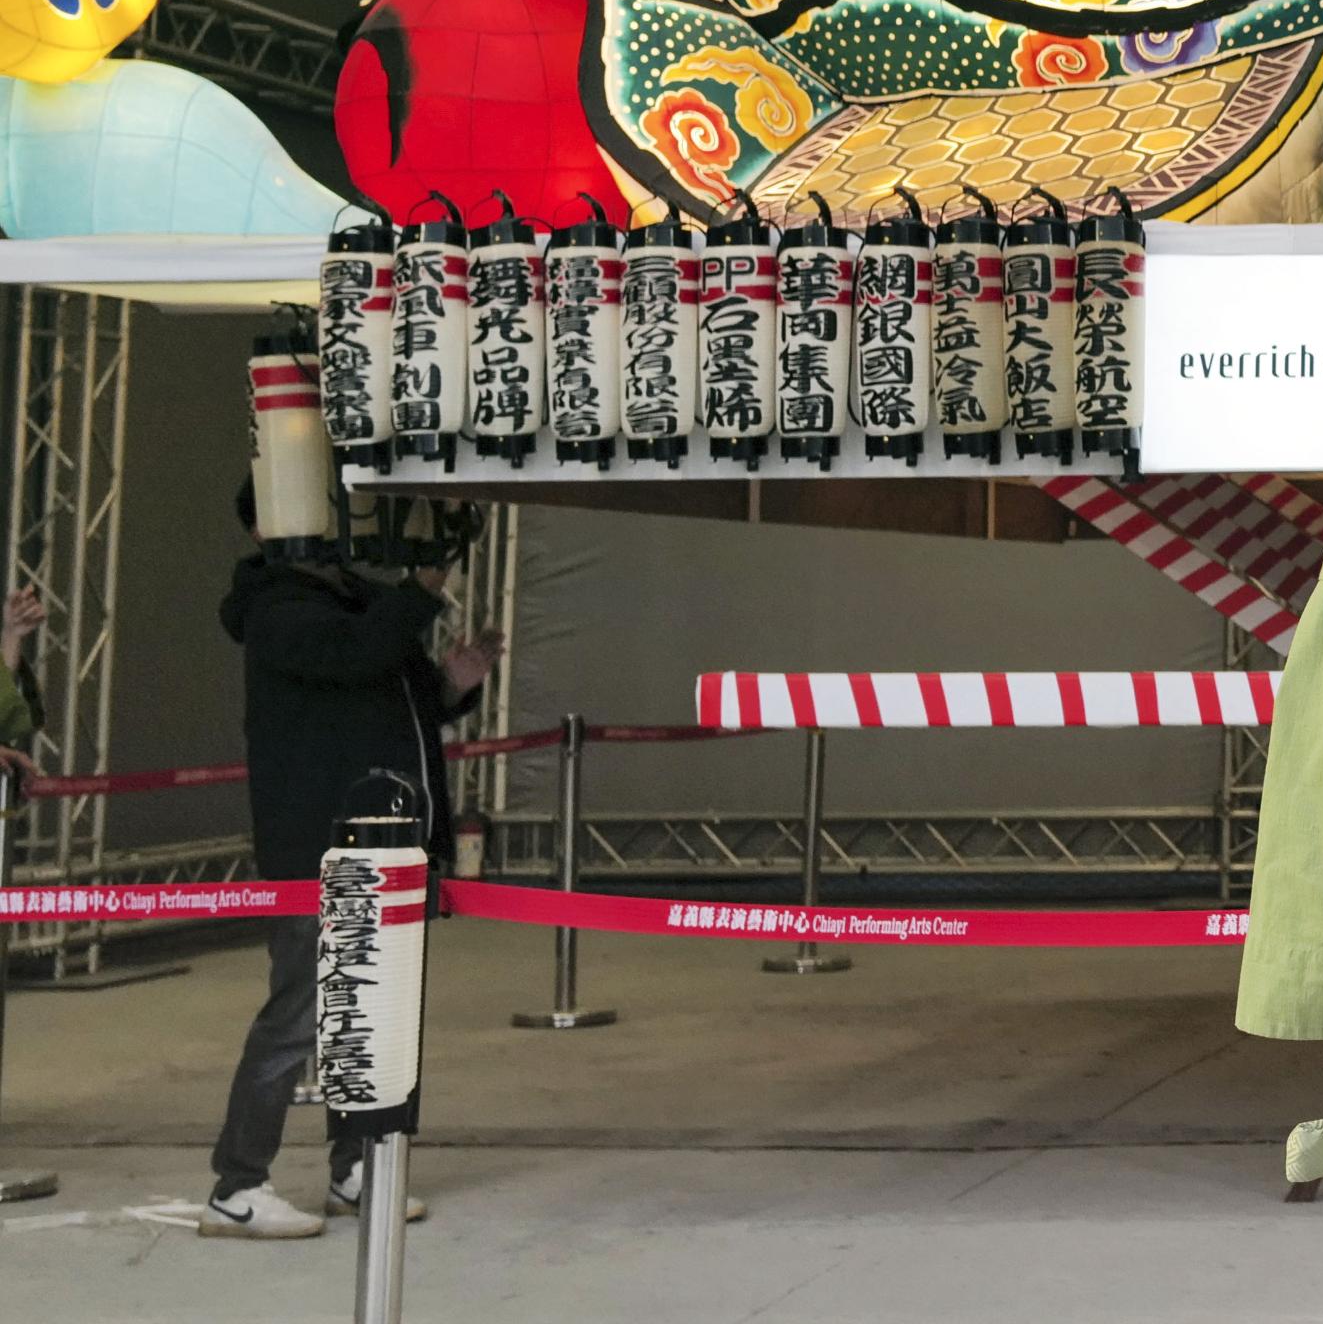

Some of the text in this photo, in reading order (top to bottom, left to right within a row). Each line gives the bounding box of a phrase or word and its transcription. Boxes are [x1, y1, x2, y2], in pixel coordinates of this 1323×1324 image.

[392, 251, 445, 431] 紙風車劇團
[623, 256, 680, 435] 三顧股份有限公司
[701, 256, 763, 432] PP石墨烯
[933, 251, 987, 426] 萬士益冷氣
[1003, 253, 1057, 430] 圓山大飯店
[1075, 247, 1133, 428] 長榮航空
[1179, 344, 1315, 379] everrich
[123, 892, 157, 914] Chiayi
[160, 889, 218, 913] Performing
[218, 889, 241, 907] Arts
[242, 887, 278, 907] Center
[667, 904, 968, 940] 嘉義縣表演藝術中心 Chiayi Performing Arts Center
